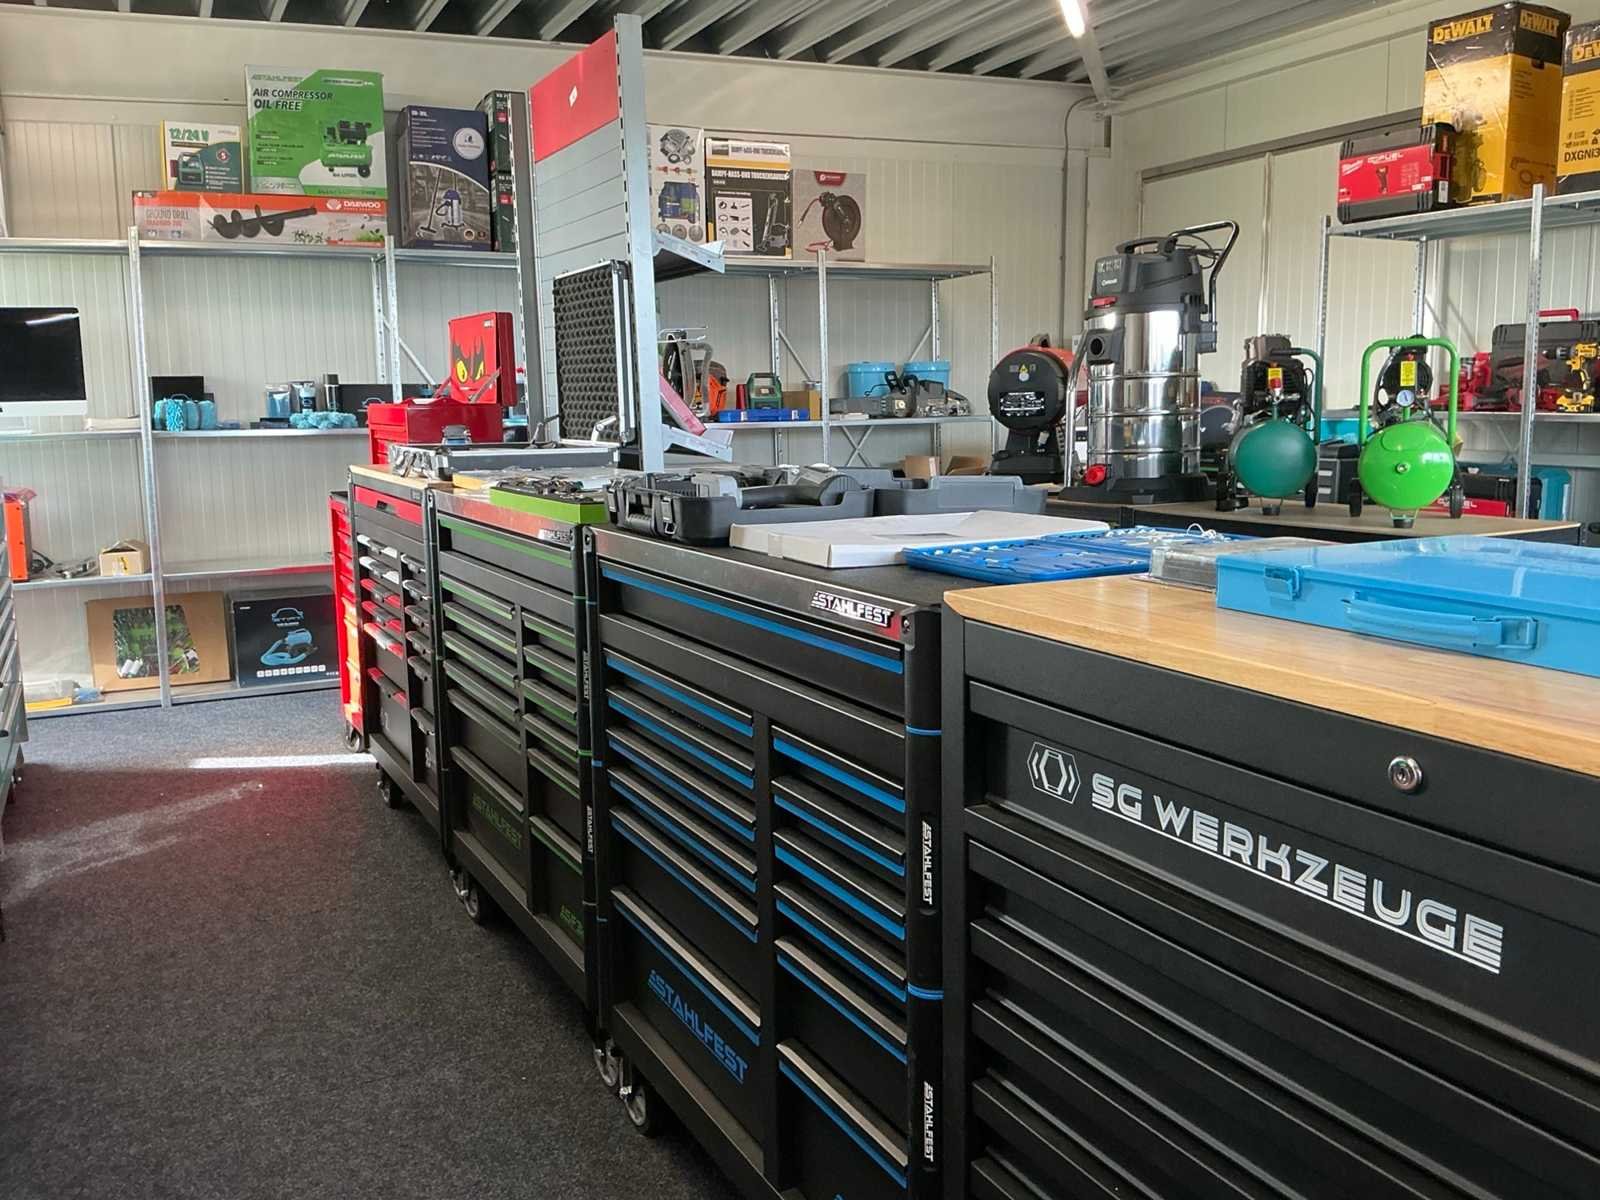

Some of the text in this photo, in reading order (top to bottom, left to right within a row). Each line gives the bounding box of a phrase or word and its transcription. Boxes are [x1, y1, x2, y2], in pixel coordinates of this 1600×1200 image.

[1433, 13, 1493, 44] DEWALT
[1520, 9, 1560, 37] DEWALT
[253, 88, 334, 100] AIR COMPRESSOR
[254, 99, 302, 111] OIL FREE
[343, 200, 381, 208] DAEWOO
[811, 591, 891, 627] STAHLFEST
[922, 820, 933, 905] STAHLFEST
[1092, 773, 1503, 969] SG WERKZEUGE
[648, 970, 748, 1084] STAHLFEST
[923, 1081, 934, 1162] STAHLFEST
